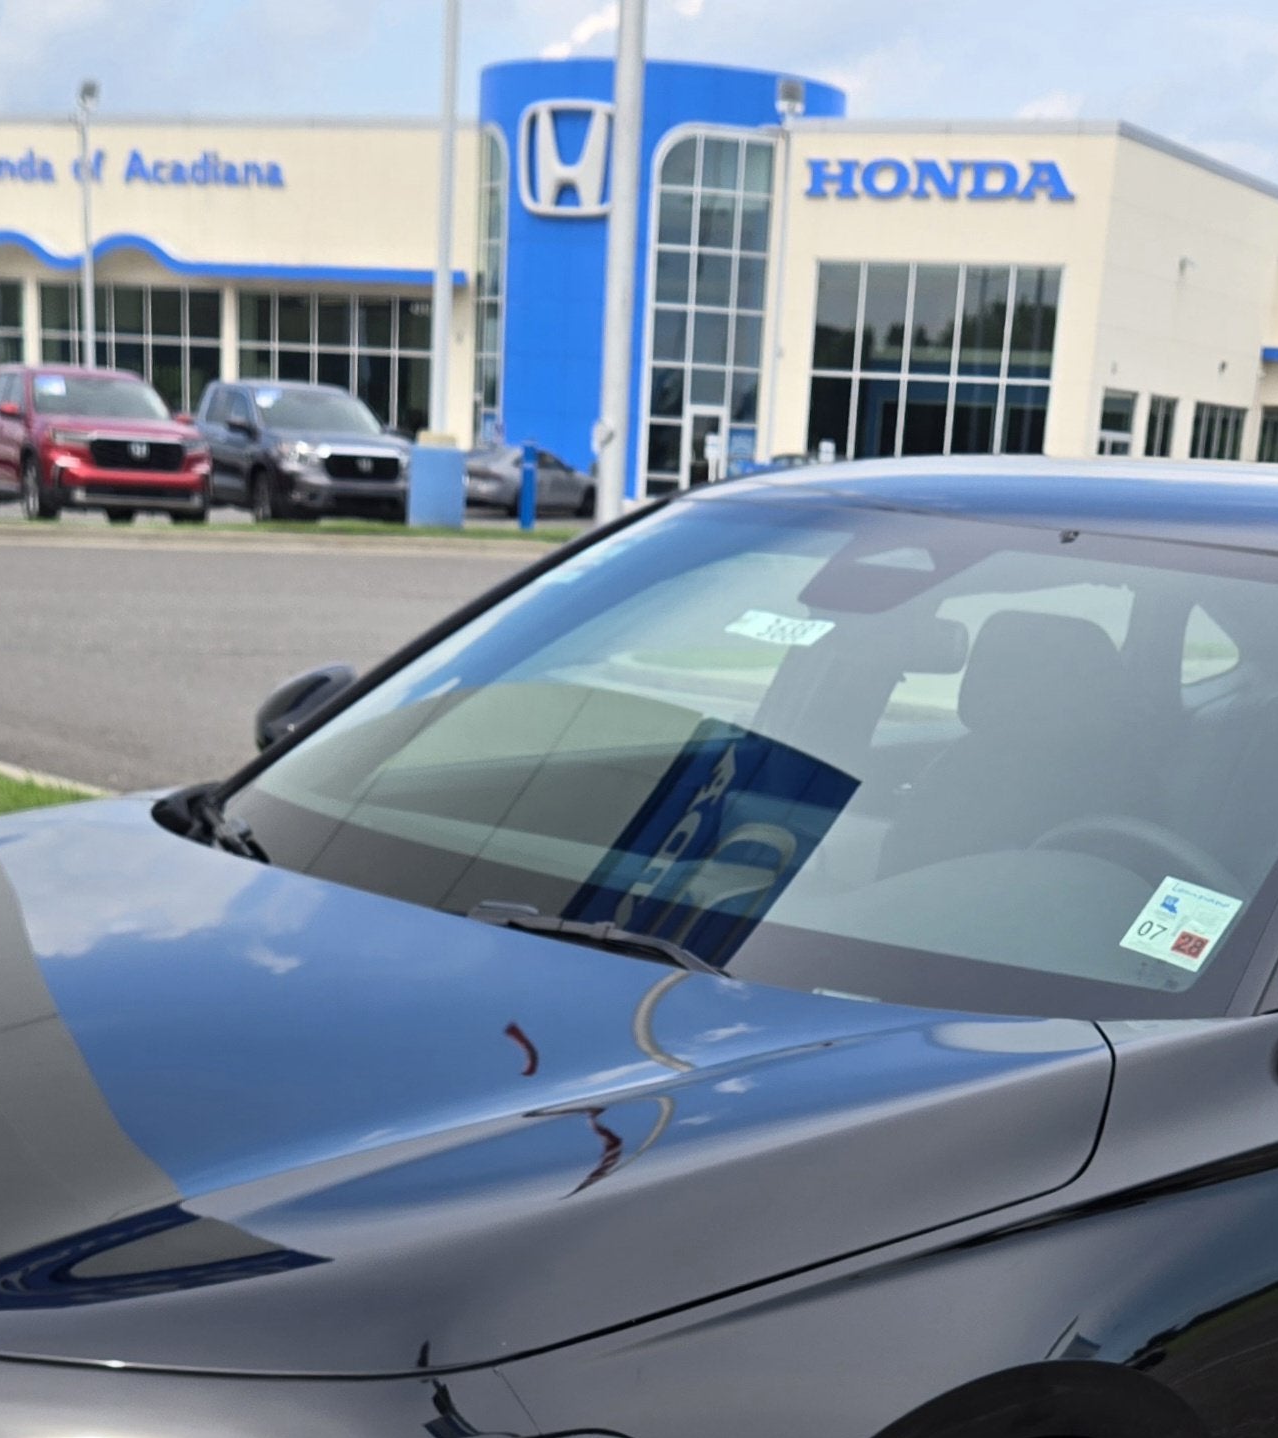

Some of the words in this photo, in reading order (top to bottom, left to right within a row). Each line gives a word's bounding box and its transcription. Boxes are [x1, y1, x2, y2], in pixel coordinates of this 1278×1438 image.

[124, 149, 285, 187] Acadiana
[805, 158, 1075, 201] HONDA
[1137, 920, 1168, 941] 07
[1174, 934, 1206, 958] 28
